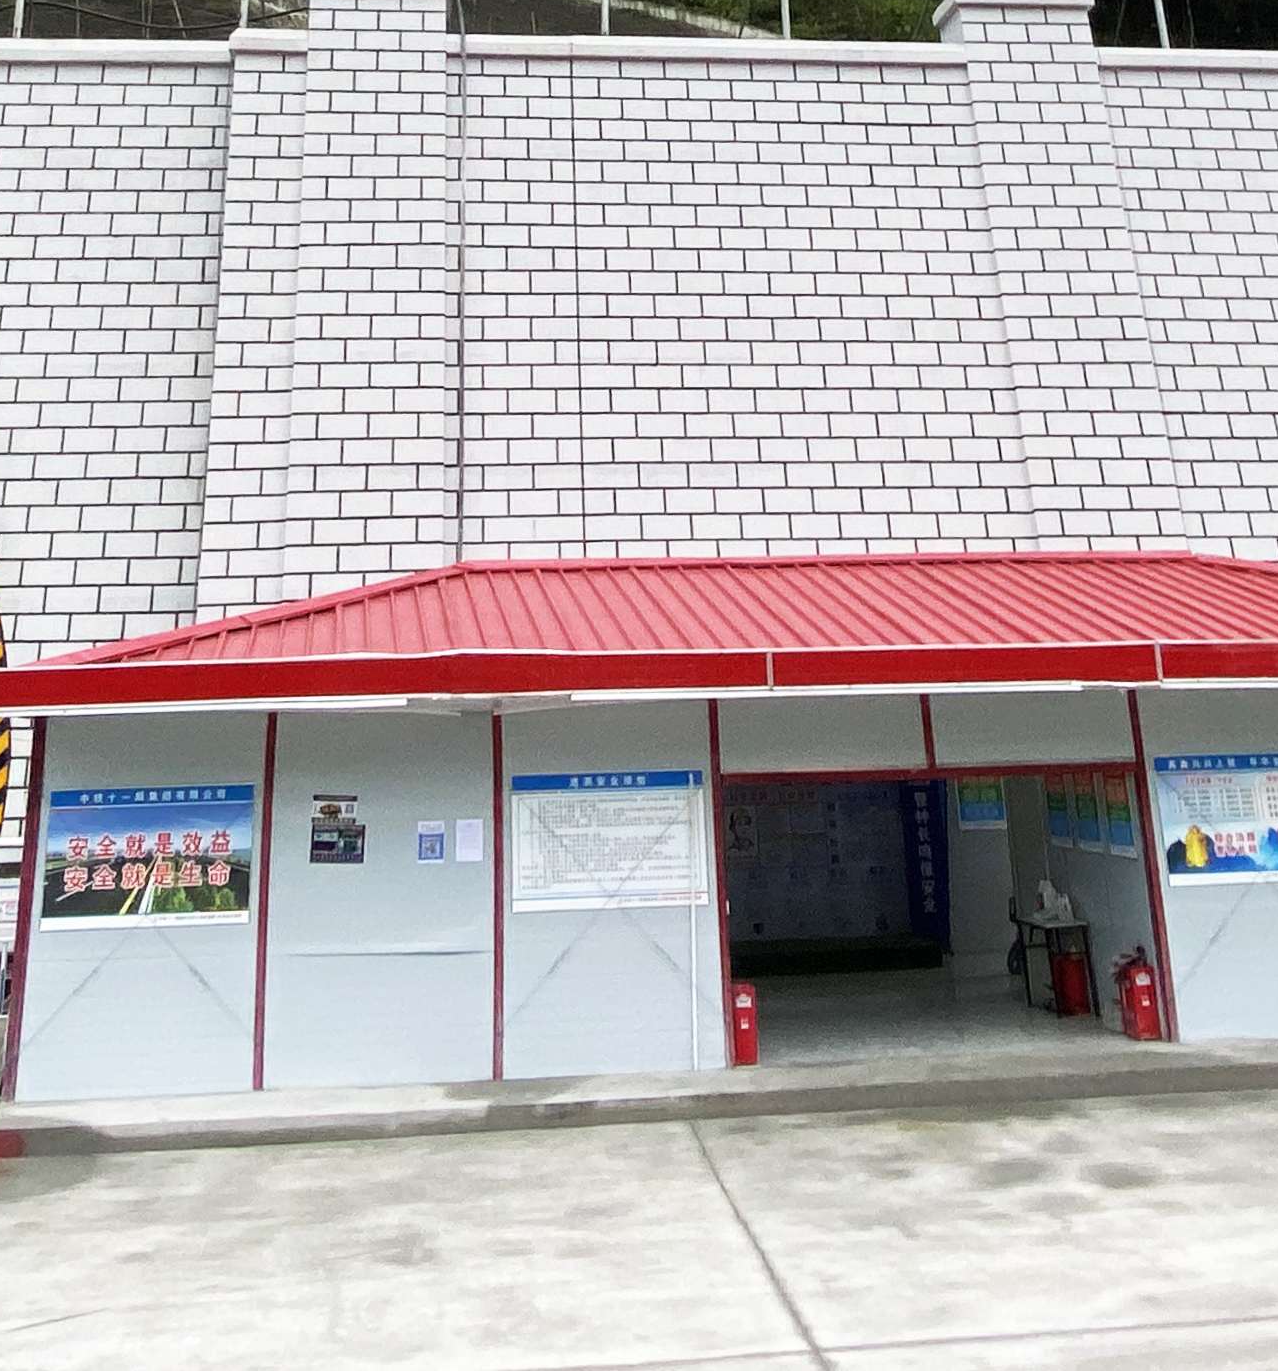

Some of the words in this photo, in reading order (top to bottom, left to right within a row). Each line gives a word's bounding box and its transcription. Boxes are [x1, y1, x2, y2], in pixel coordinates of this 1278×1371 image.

[67, 829, 231, 861] 安全就是效益
[64, 860, 231, 893] 安全就是生命
